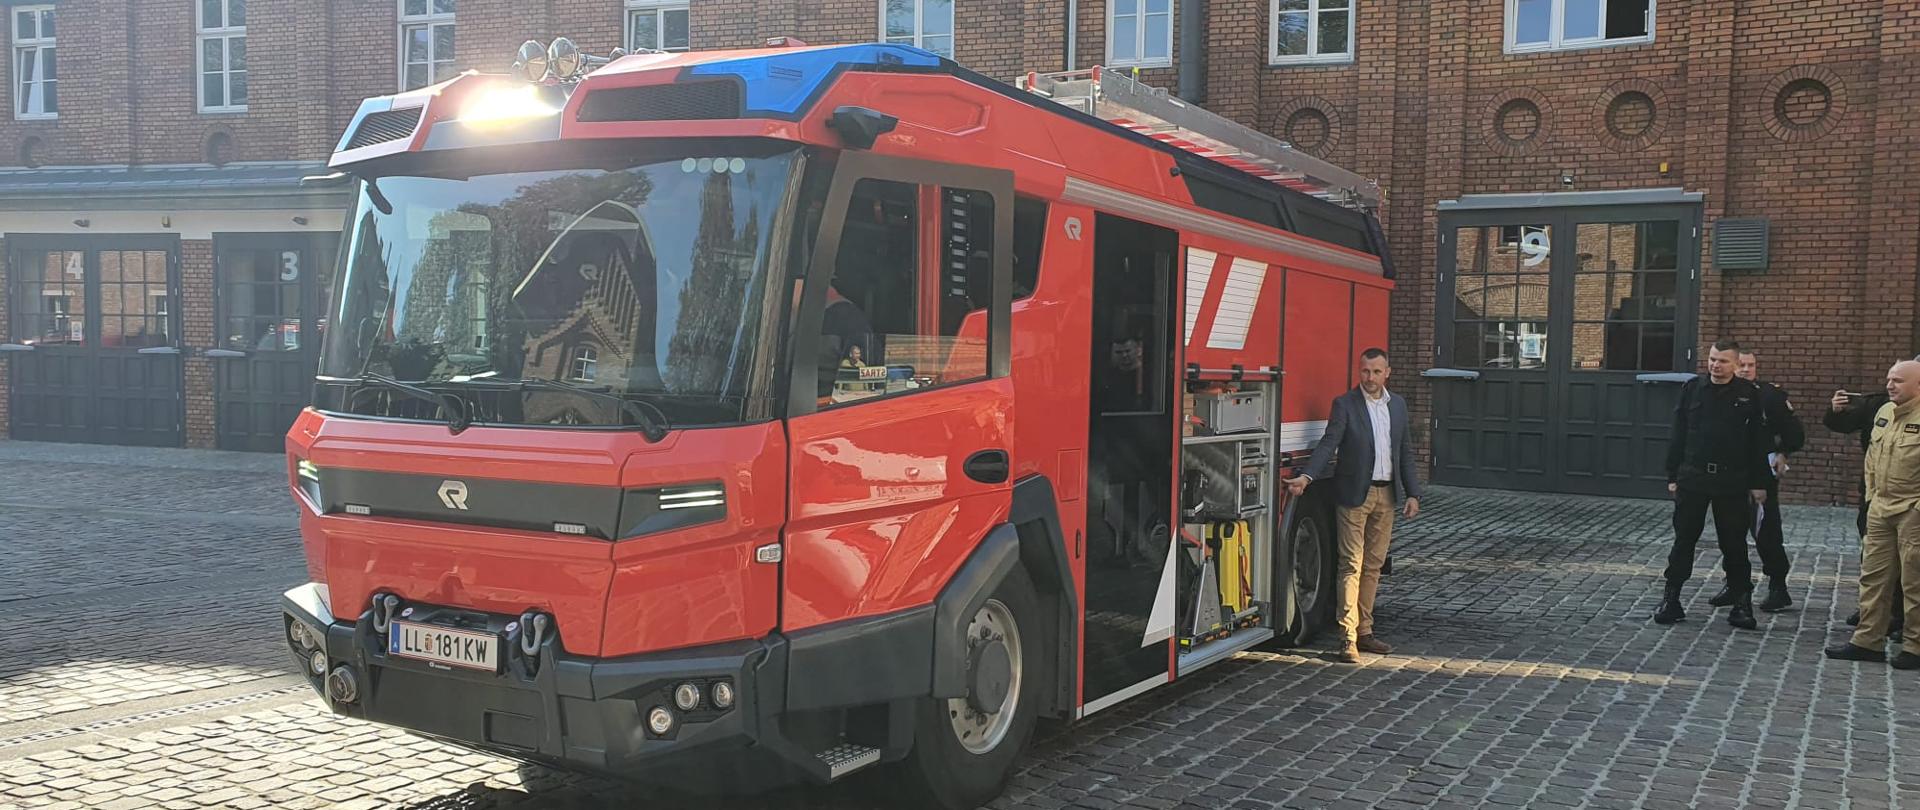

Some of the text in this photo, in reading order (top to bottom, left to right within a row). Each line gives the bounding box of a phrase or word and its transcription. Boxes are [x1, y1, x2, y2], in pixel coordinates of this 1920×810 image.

[1523, 231, 1548, 266] 9
[66, 252, 84, 280] 4
[281, 251, 298, 281] 3
[405, 628, 487, 663] LL 181KW
